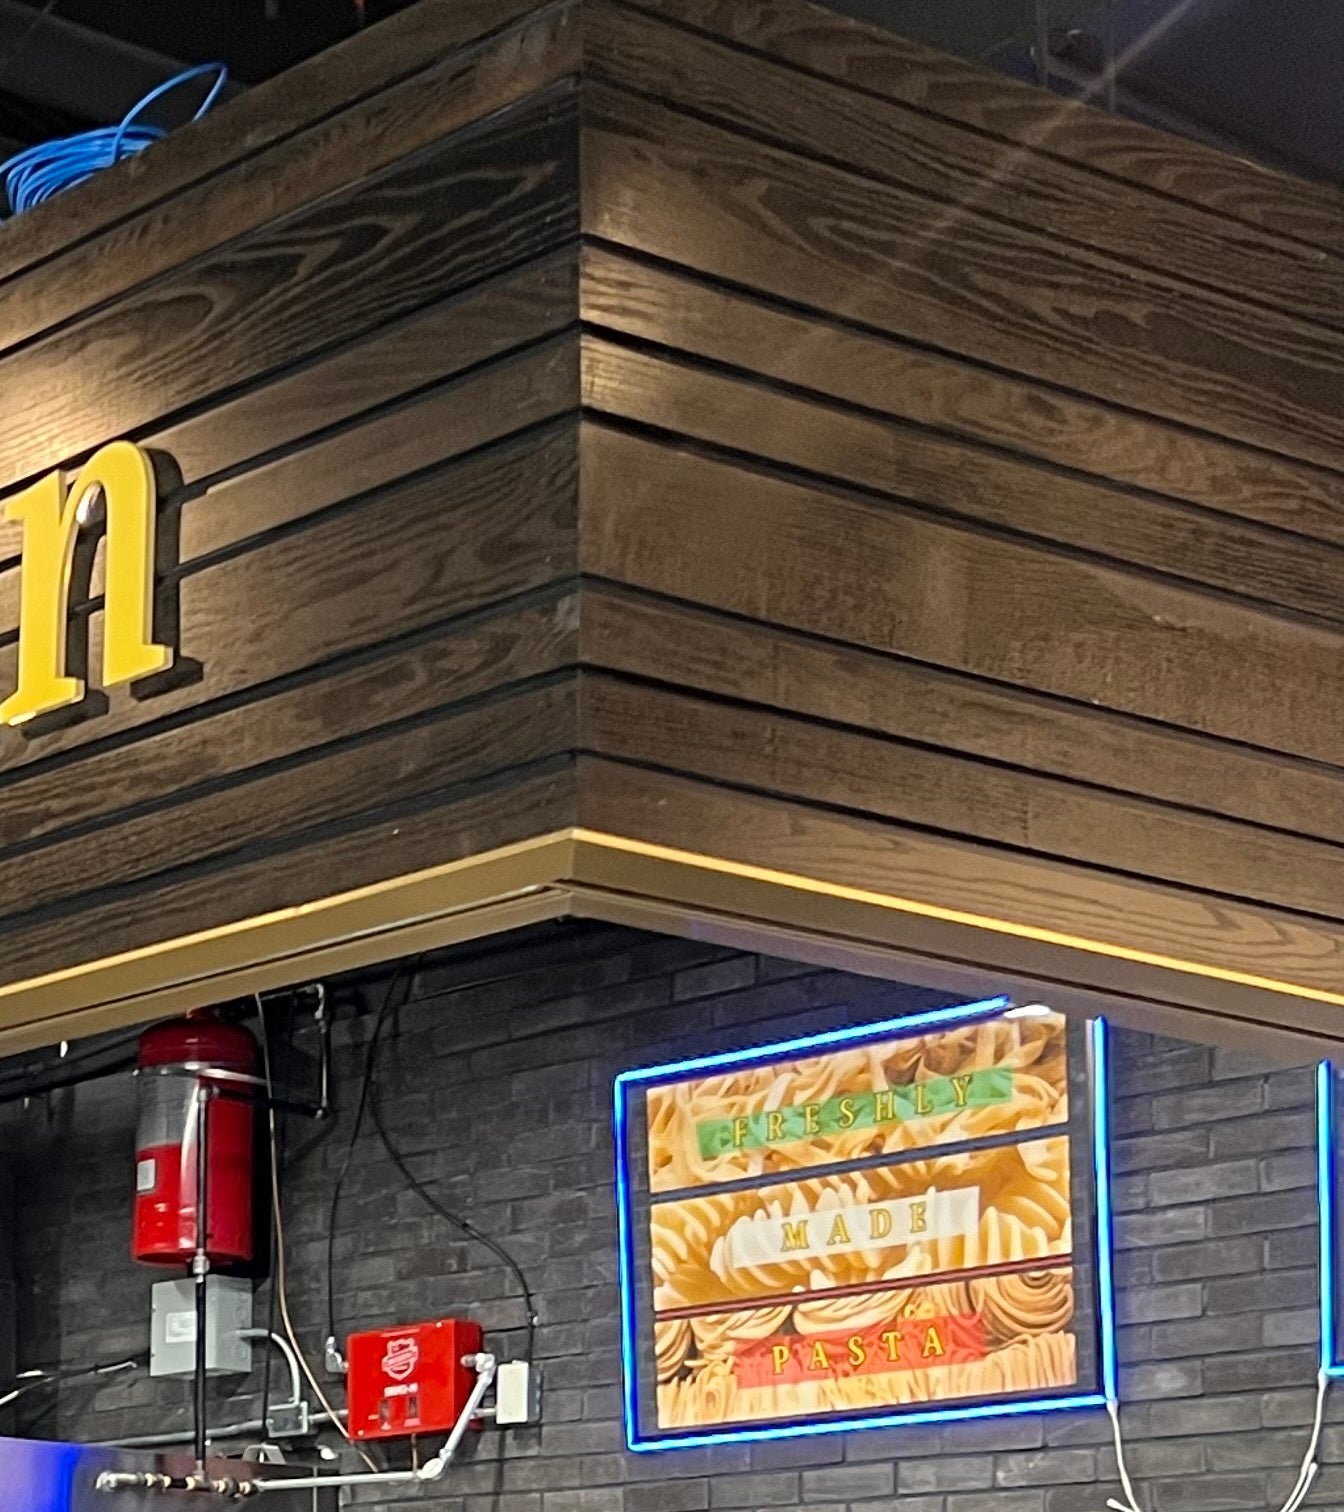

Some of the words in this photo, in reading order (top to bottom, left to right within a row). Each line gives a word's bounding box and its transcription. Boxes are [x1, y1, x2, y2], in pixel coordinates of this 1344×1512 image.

[730, 1074, 976, 1148] FRESHLY
[780, 1199, 930, 1253] MADE
[770, 1326, 948, 1376] PASTA
